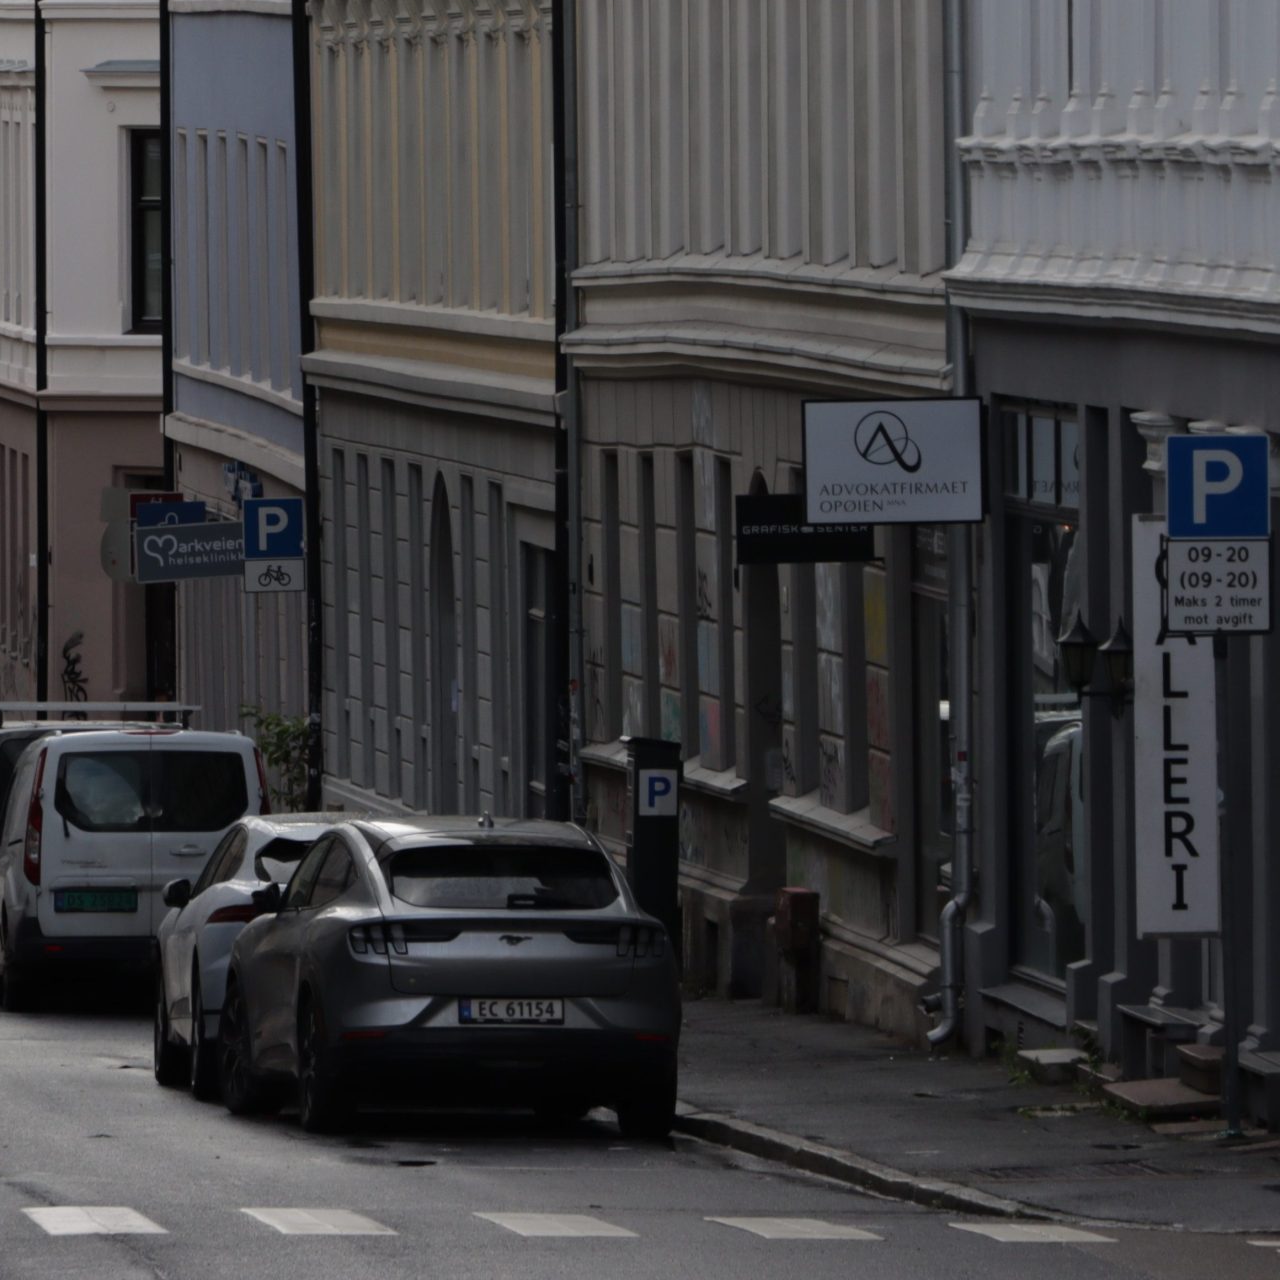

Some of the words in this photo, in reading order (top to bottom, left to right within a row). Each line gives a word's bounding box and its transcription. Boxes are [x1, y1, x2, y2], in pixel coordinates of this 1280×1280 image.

[819, 481, 968, 496] ADVOKATFIRMAET
[1193, 449, 1244, 524] P
[820, 499, 883, 513] OPØIEN
[258, 506, 289, 551] P
[742, 524, 799, 535] GRAFISK
[1174, 596, 1207, 608] Maks
[1215, 596, 1223, 608] 2
[1230, 596, 1263, 608] timer
[1184, 614, 1208, 625] mot
[1216, 613, 1254, 628] avgift
[648, 776, 672, 808] P
[478, 1001, 498, 1017] EC
[505, 1001, 555, 1017] 61154
